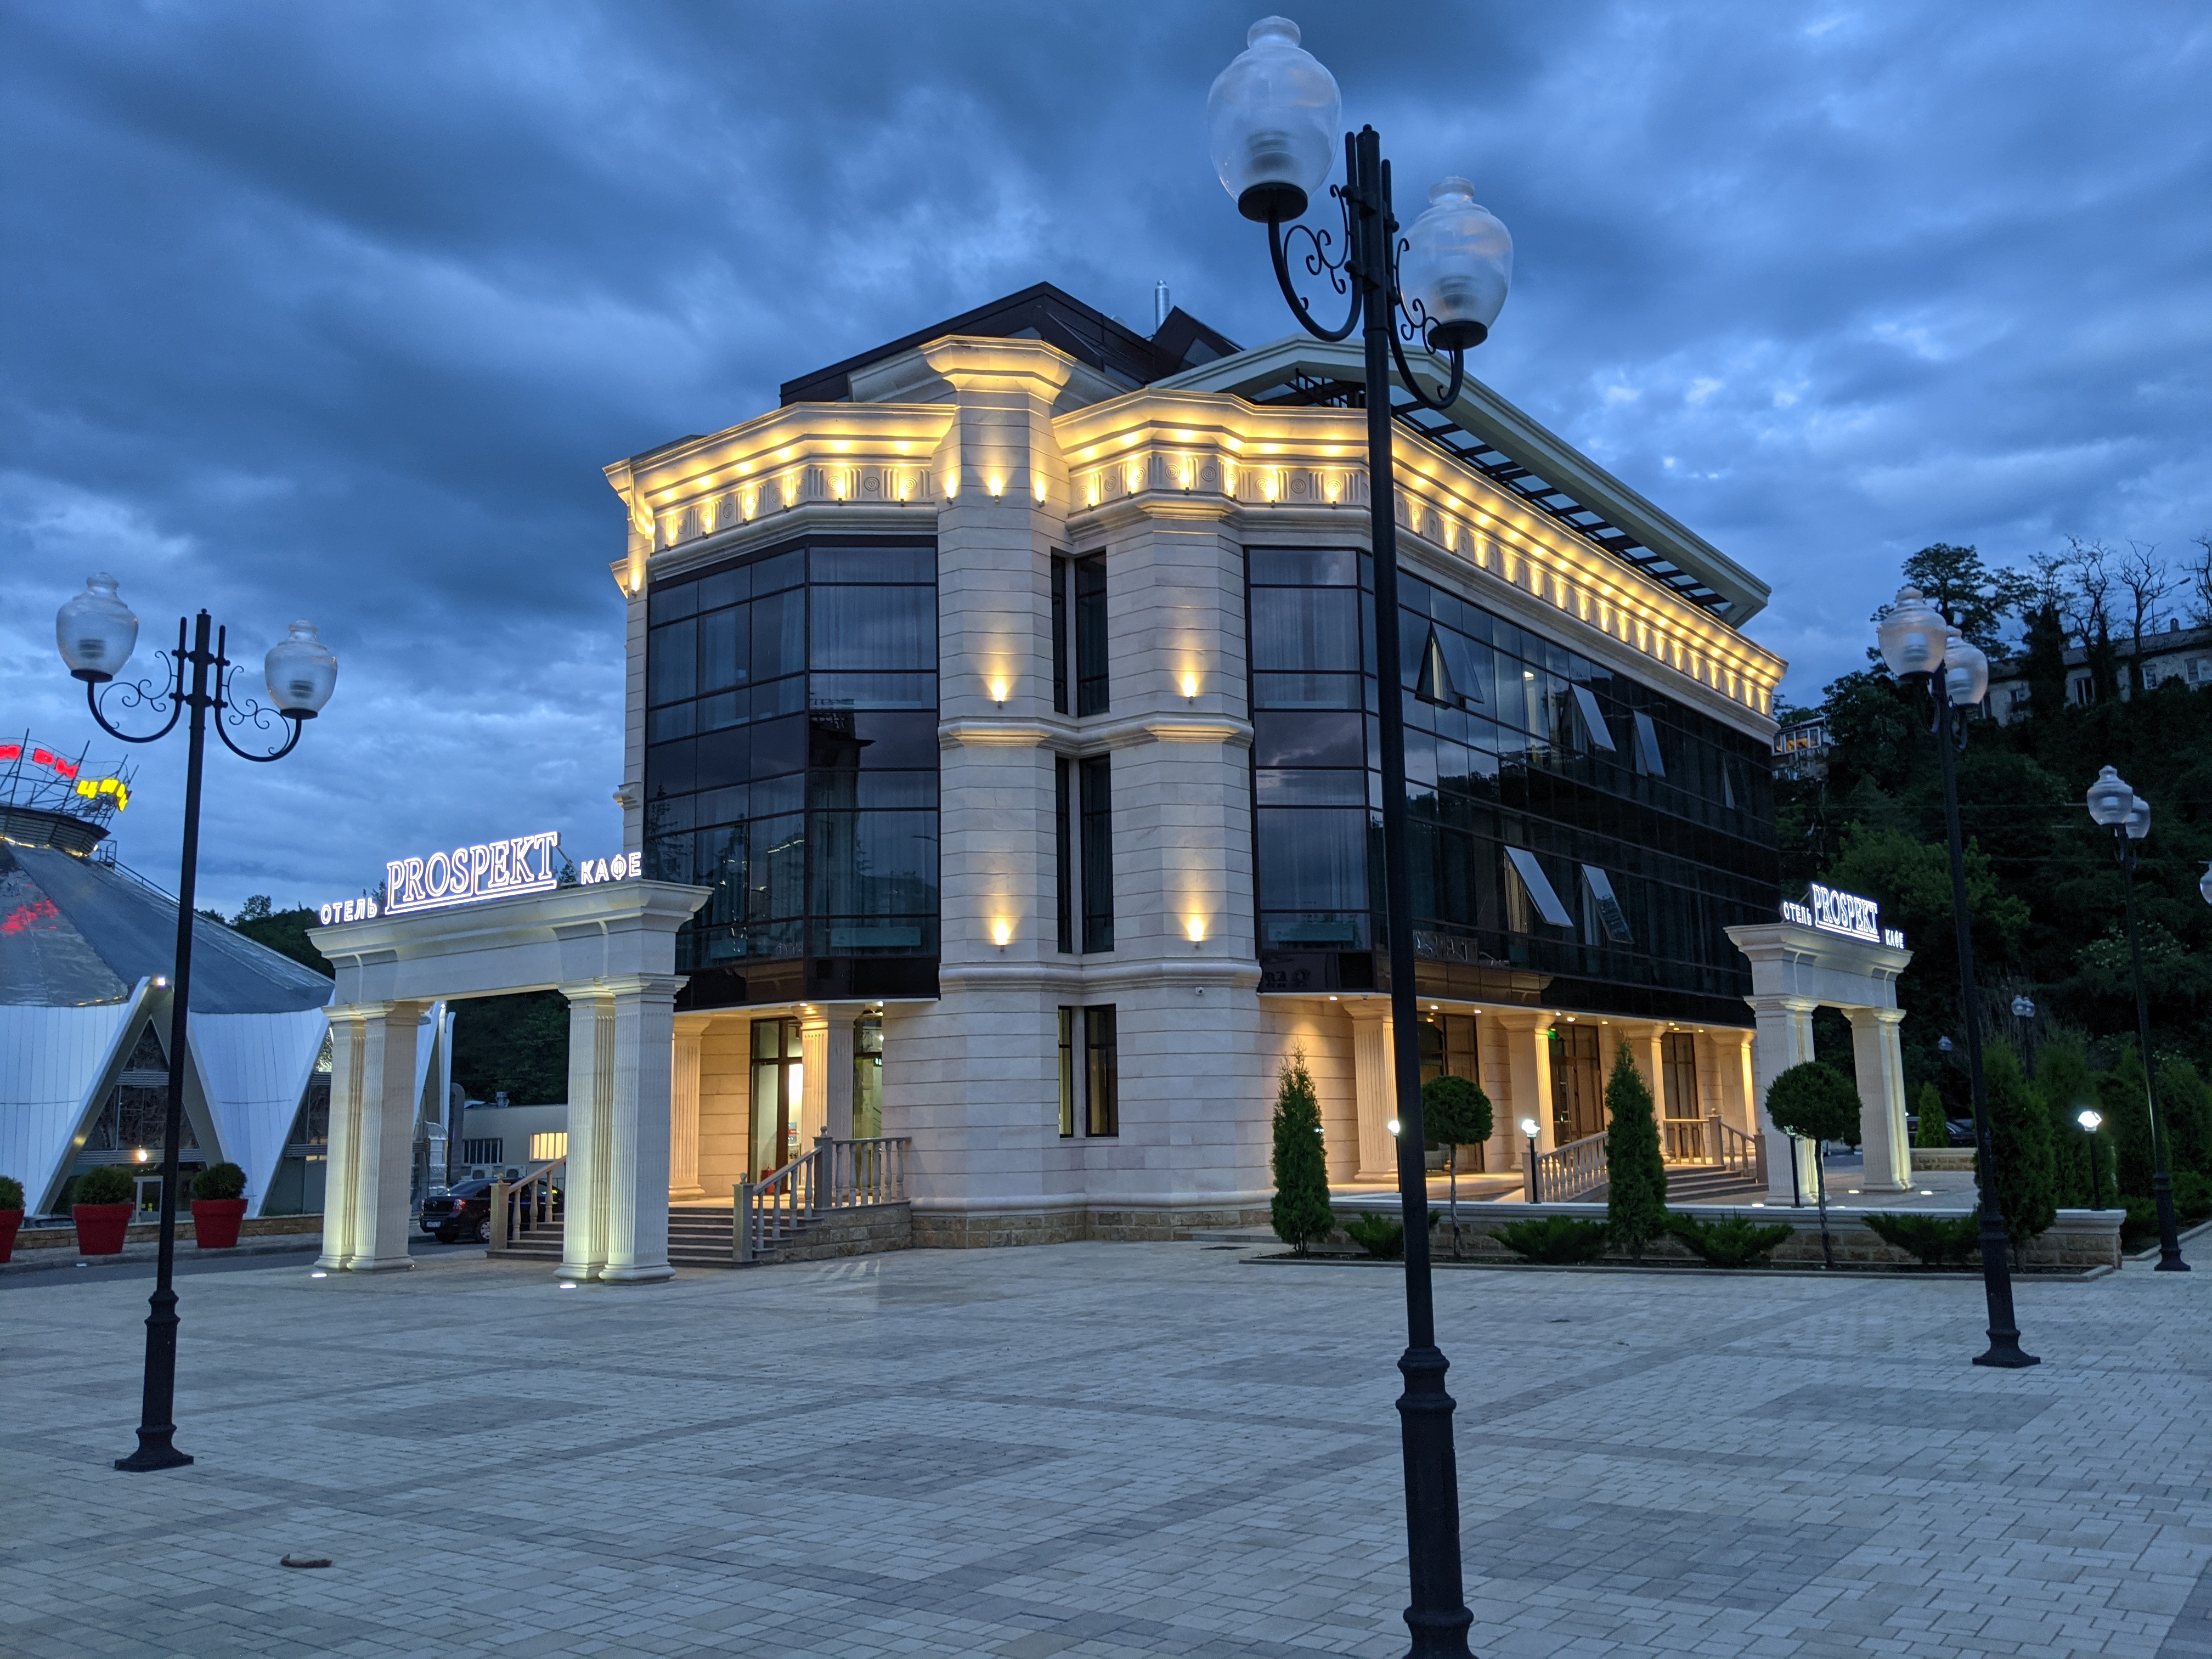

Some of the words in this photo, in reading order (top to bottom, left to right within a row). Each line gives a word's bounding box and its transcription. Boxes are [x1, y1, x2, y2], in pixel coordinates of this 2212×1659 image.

[320, 896, 377, 925] ОТЕЛЬ
[385, 831, 558, 915] PROSPEKT
[580, 851, 641, 885] КАФЕ
[1784, 901, 1813, 926] ОТЕЛЬ
[1812, 883, 1878, 936] PROSPEKT
[1885, 928, 1904, 949] КАФЕ
